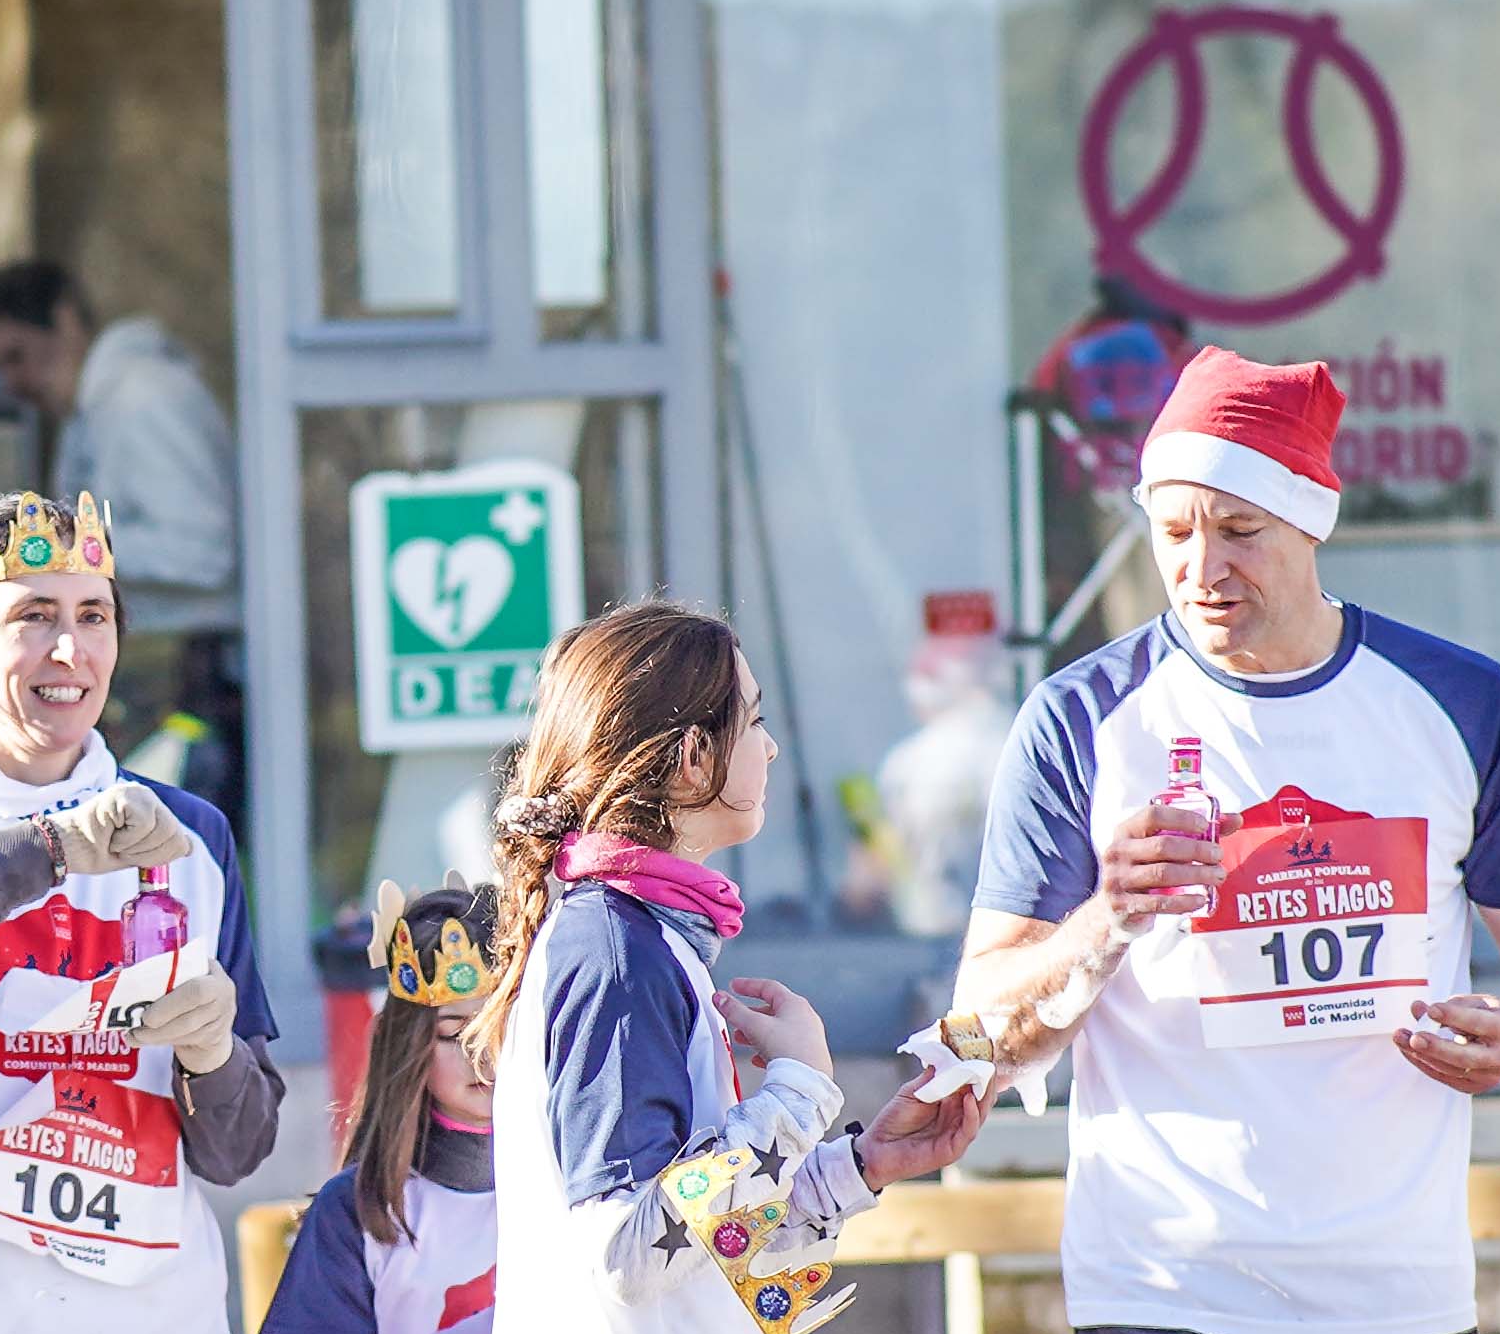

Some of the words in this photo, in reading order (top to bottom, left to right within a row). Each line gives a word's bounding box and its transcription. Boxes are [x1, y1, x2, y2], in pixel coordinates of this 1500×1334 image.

[1332, 338, 1446, 411] IÓN
[1256, 867, 1313, 885] CARRERA
[1314, 864, 1372, 877] POPULAR
[1236, 888, 1308, 923] REYES
[1315, 879, 1395, 917] MAGOS
[1260, 922, 1385, 986] 107
[1307, 997, 1376, 1013] Comunidad
[1309, 1014, 1326, 1026] de
[1330, 1009, 1377, 1024] Madrid
[78, 1114, 124, 1140] POPULAR
[2, 1125, 67, 1159] REYES
[72, 1135, 138, 1177] MAGOS
[15, 1163, 121, 1232] 104
